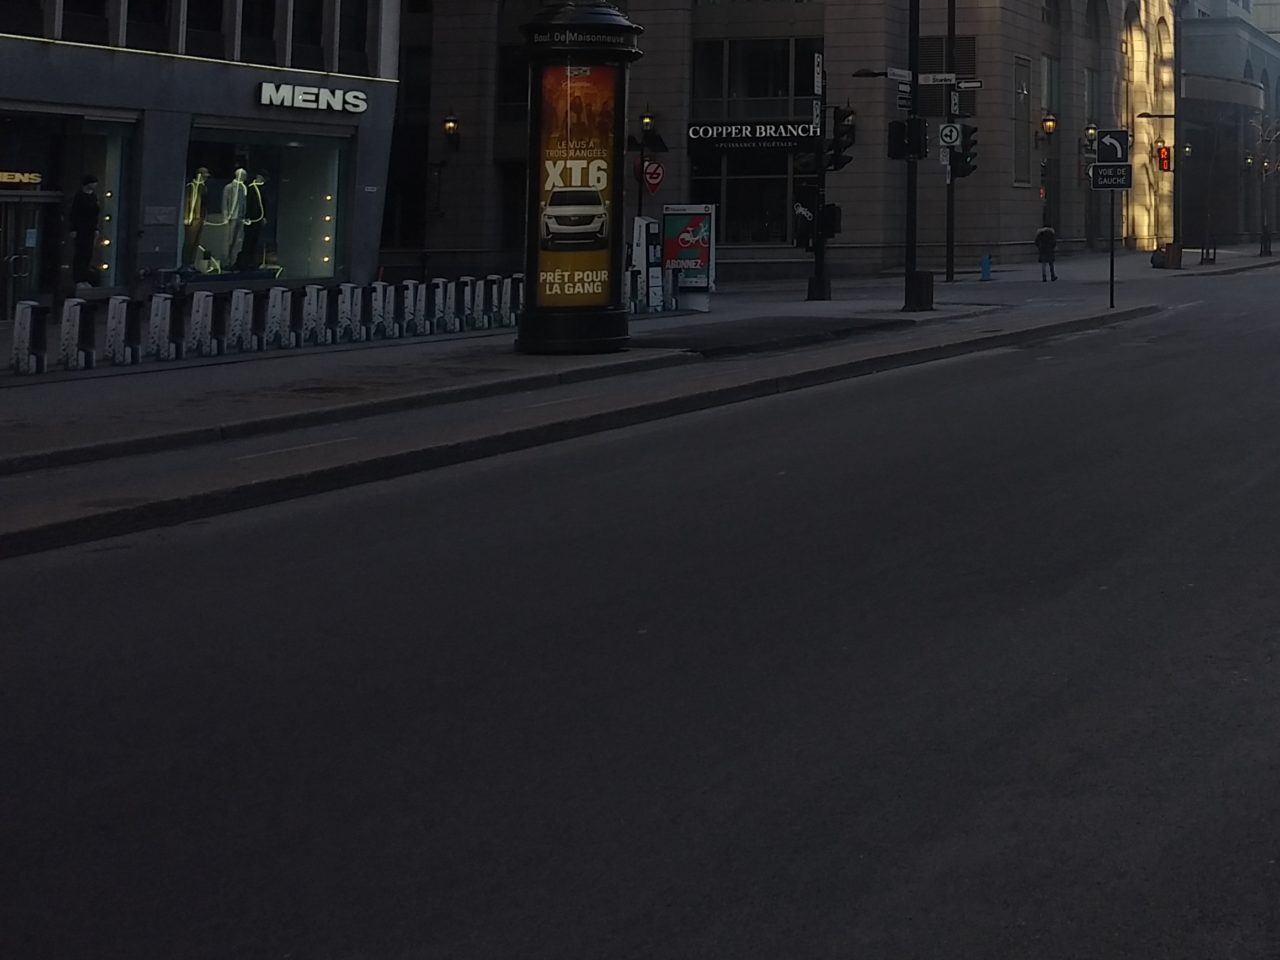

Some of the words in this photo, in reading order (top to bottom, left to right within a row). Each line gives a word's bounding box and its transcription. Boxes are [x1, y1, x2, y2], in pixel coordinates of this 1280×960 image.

[261, 82, 368, 113] MENS
[688, 125, 752, 139] COPPER
[755, 123, 821, 138] BRANCH
[0, 172, 43, 184] ENS
[544, 159, 608, 191] XT6
[1098, 168, 1114, 176] VOIE
[1098, 177, 1126, 185] GAUCHE
[540, 269, 571, 283] PRÊT
[574, 270, 609, 282] POUR
[545, 283, 561, 295] LA
[564, 281, 602, 295] GANG
